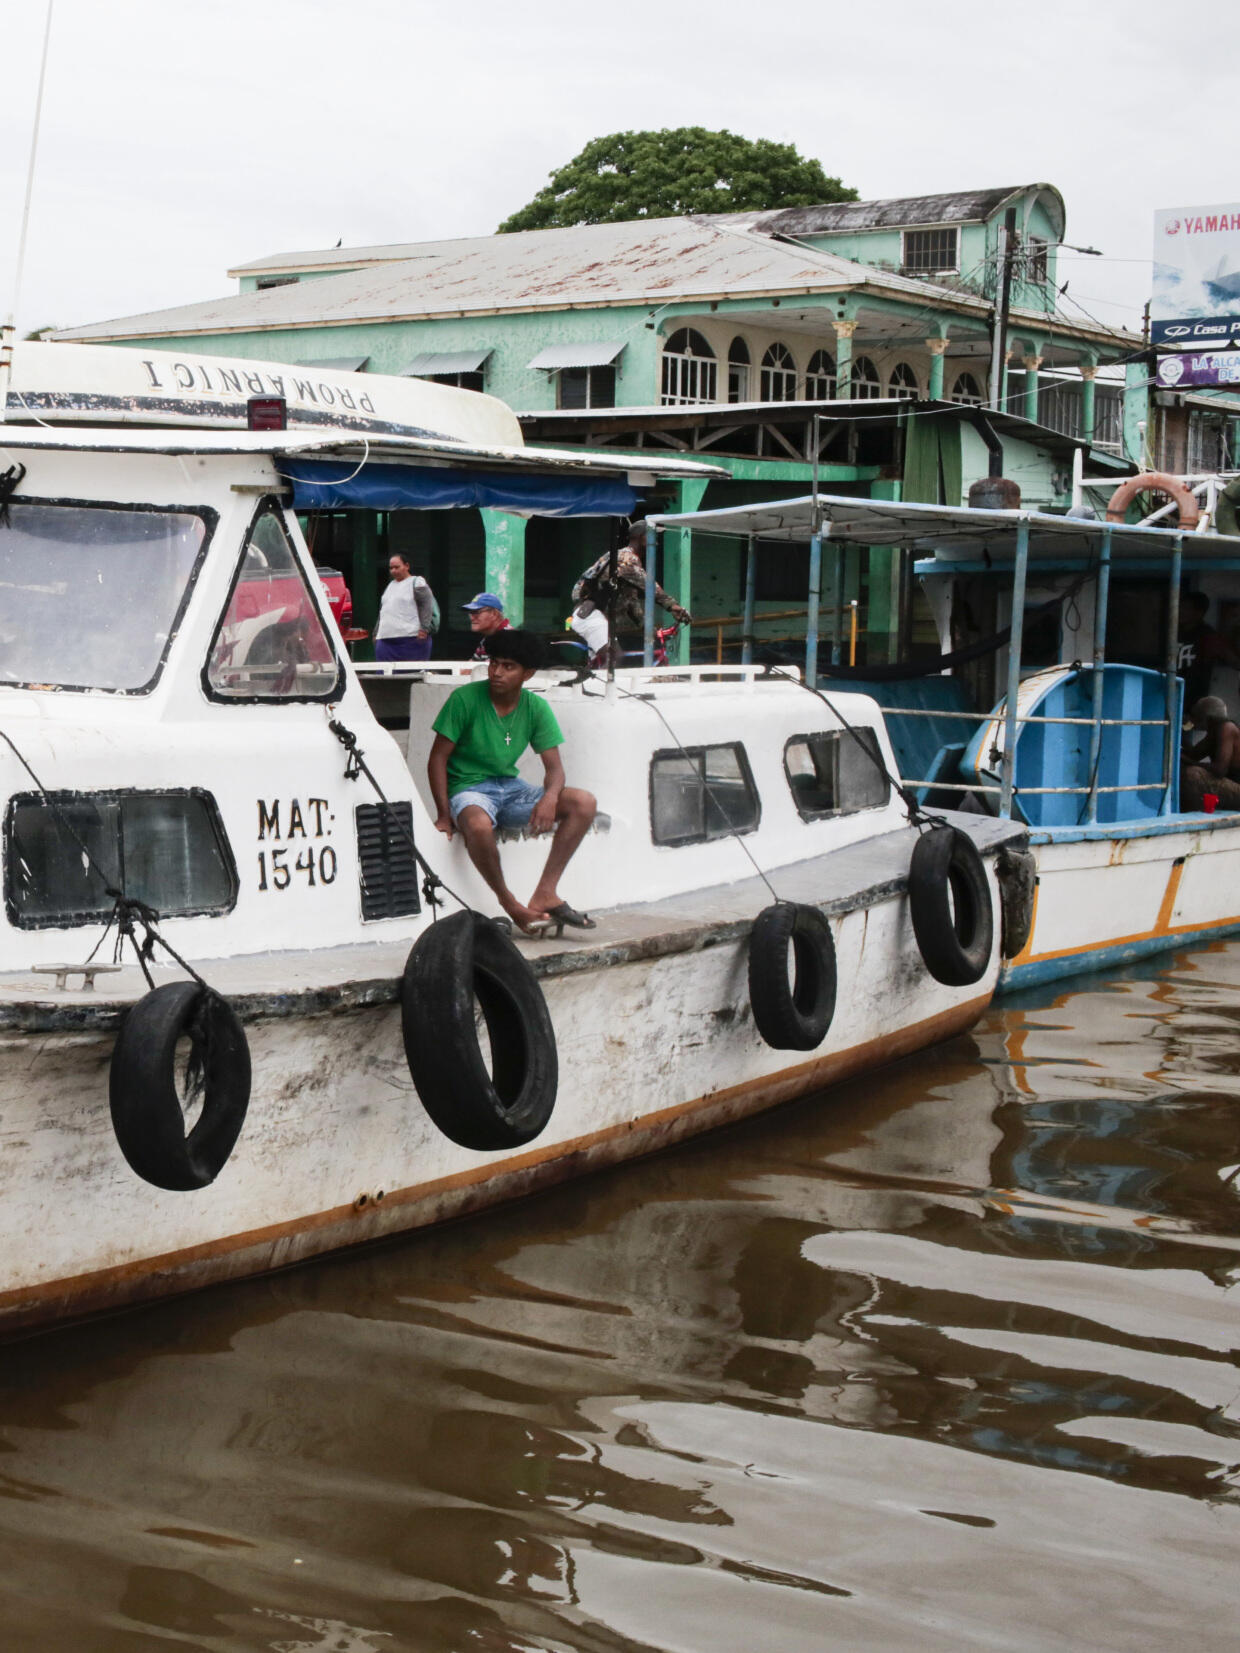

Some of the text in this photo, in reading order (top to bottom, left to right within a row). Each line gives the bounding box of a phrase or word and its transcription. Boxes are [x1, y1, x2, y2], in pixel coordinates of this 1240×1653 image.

[1194, 324, 1227, 335] Casa
[1193, 357, 1208, 369] LA
[1219, 369, 1234, 380] DE
[142, 360, 376, 414] PROMARNICI
[257, 798, 335, 840] MAT:
[258, 846, 337, 890] 1540
